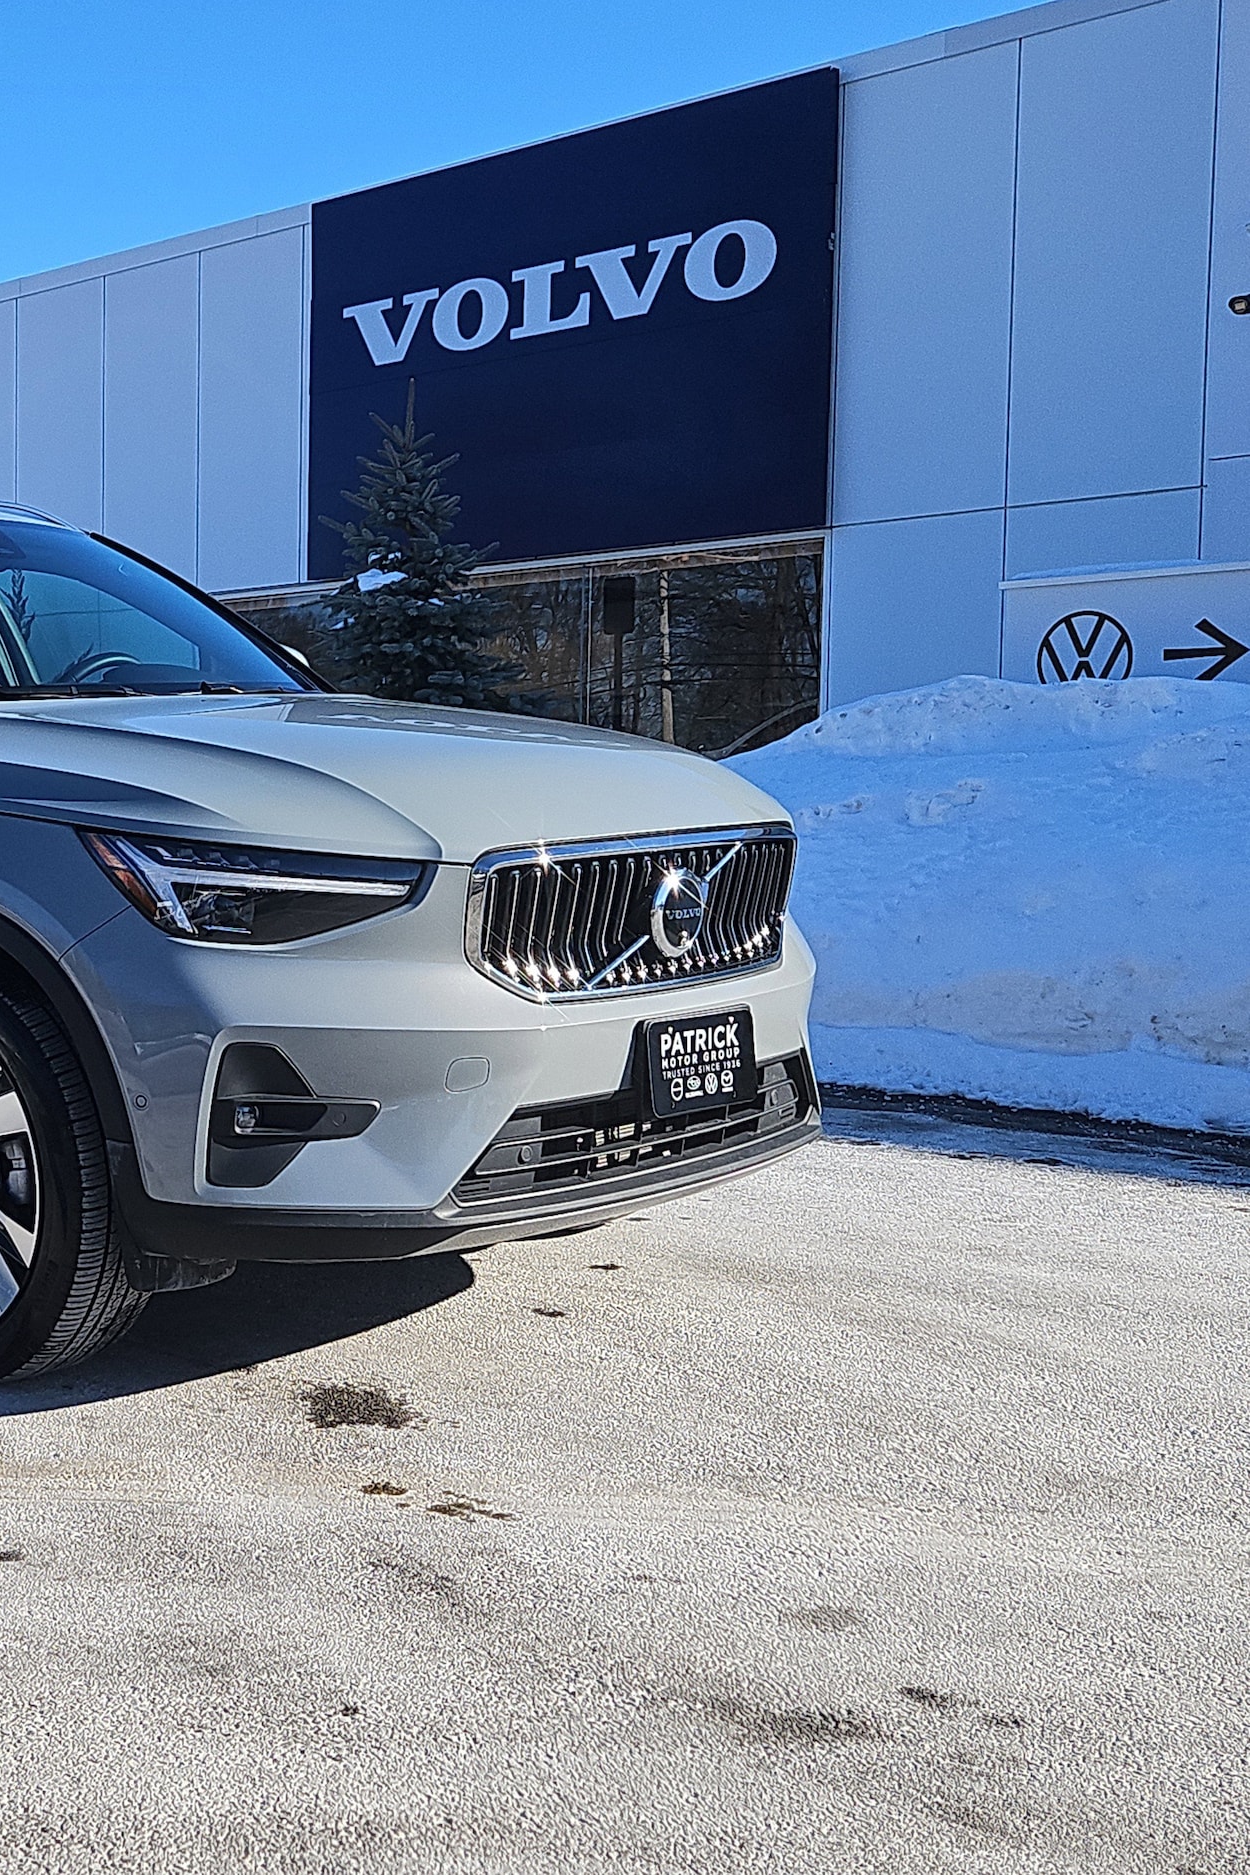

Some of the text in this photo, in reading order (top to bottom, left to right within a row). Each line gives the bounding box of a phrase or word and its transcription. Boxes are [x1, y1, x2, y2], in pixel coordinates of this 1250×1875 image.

[343, 219, 777, 366] VOLVO
[665, 908, 701, 920] VOLVO
[660, 1023, 739, 1057] PATRICK
[662, 1047, 739, 1069] MOTOR GROUP
[662, 1067, 695, 1080] TRUSTED
[698, 1062, 720, 1073] SINCE
